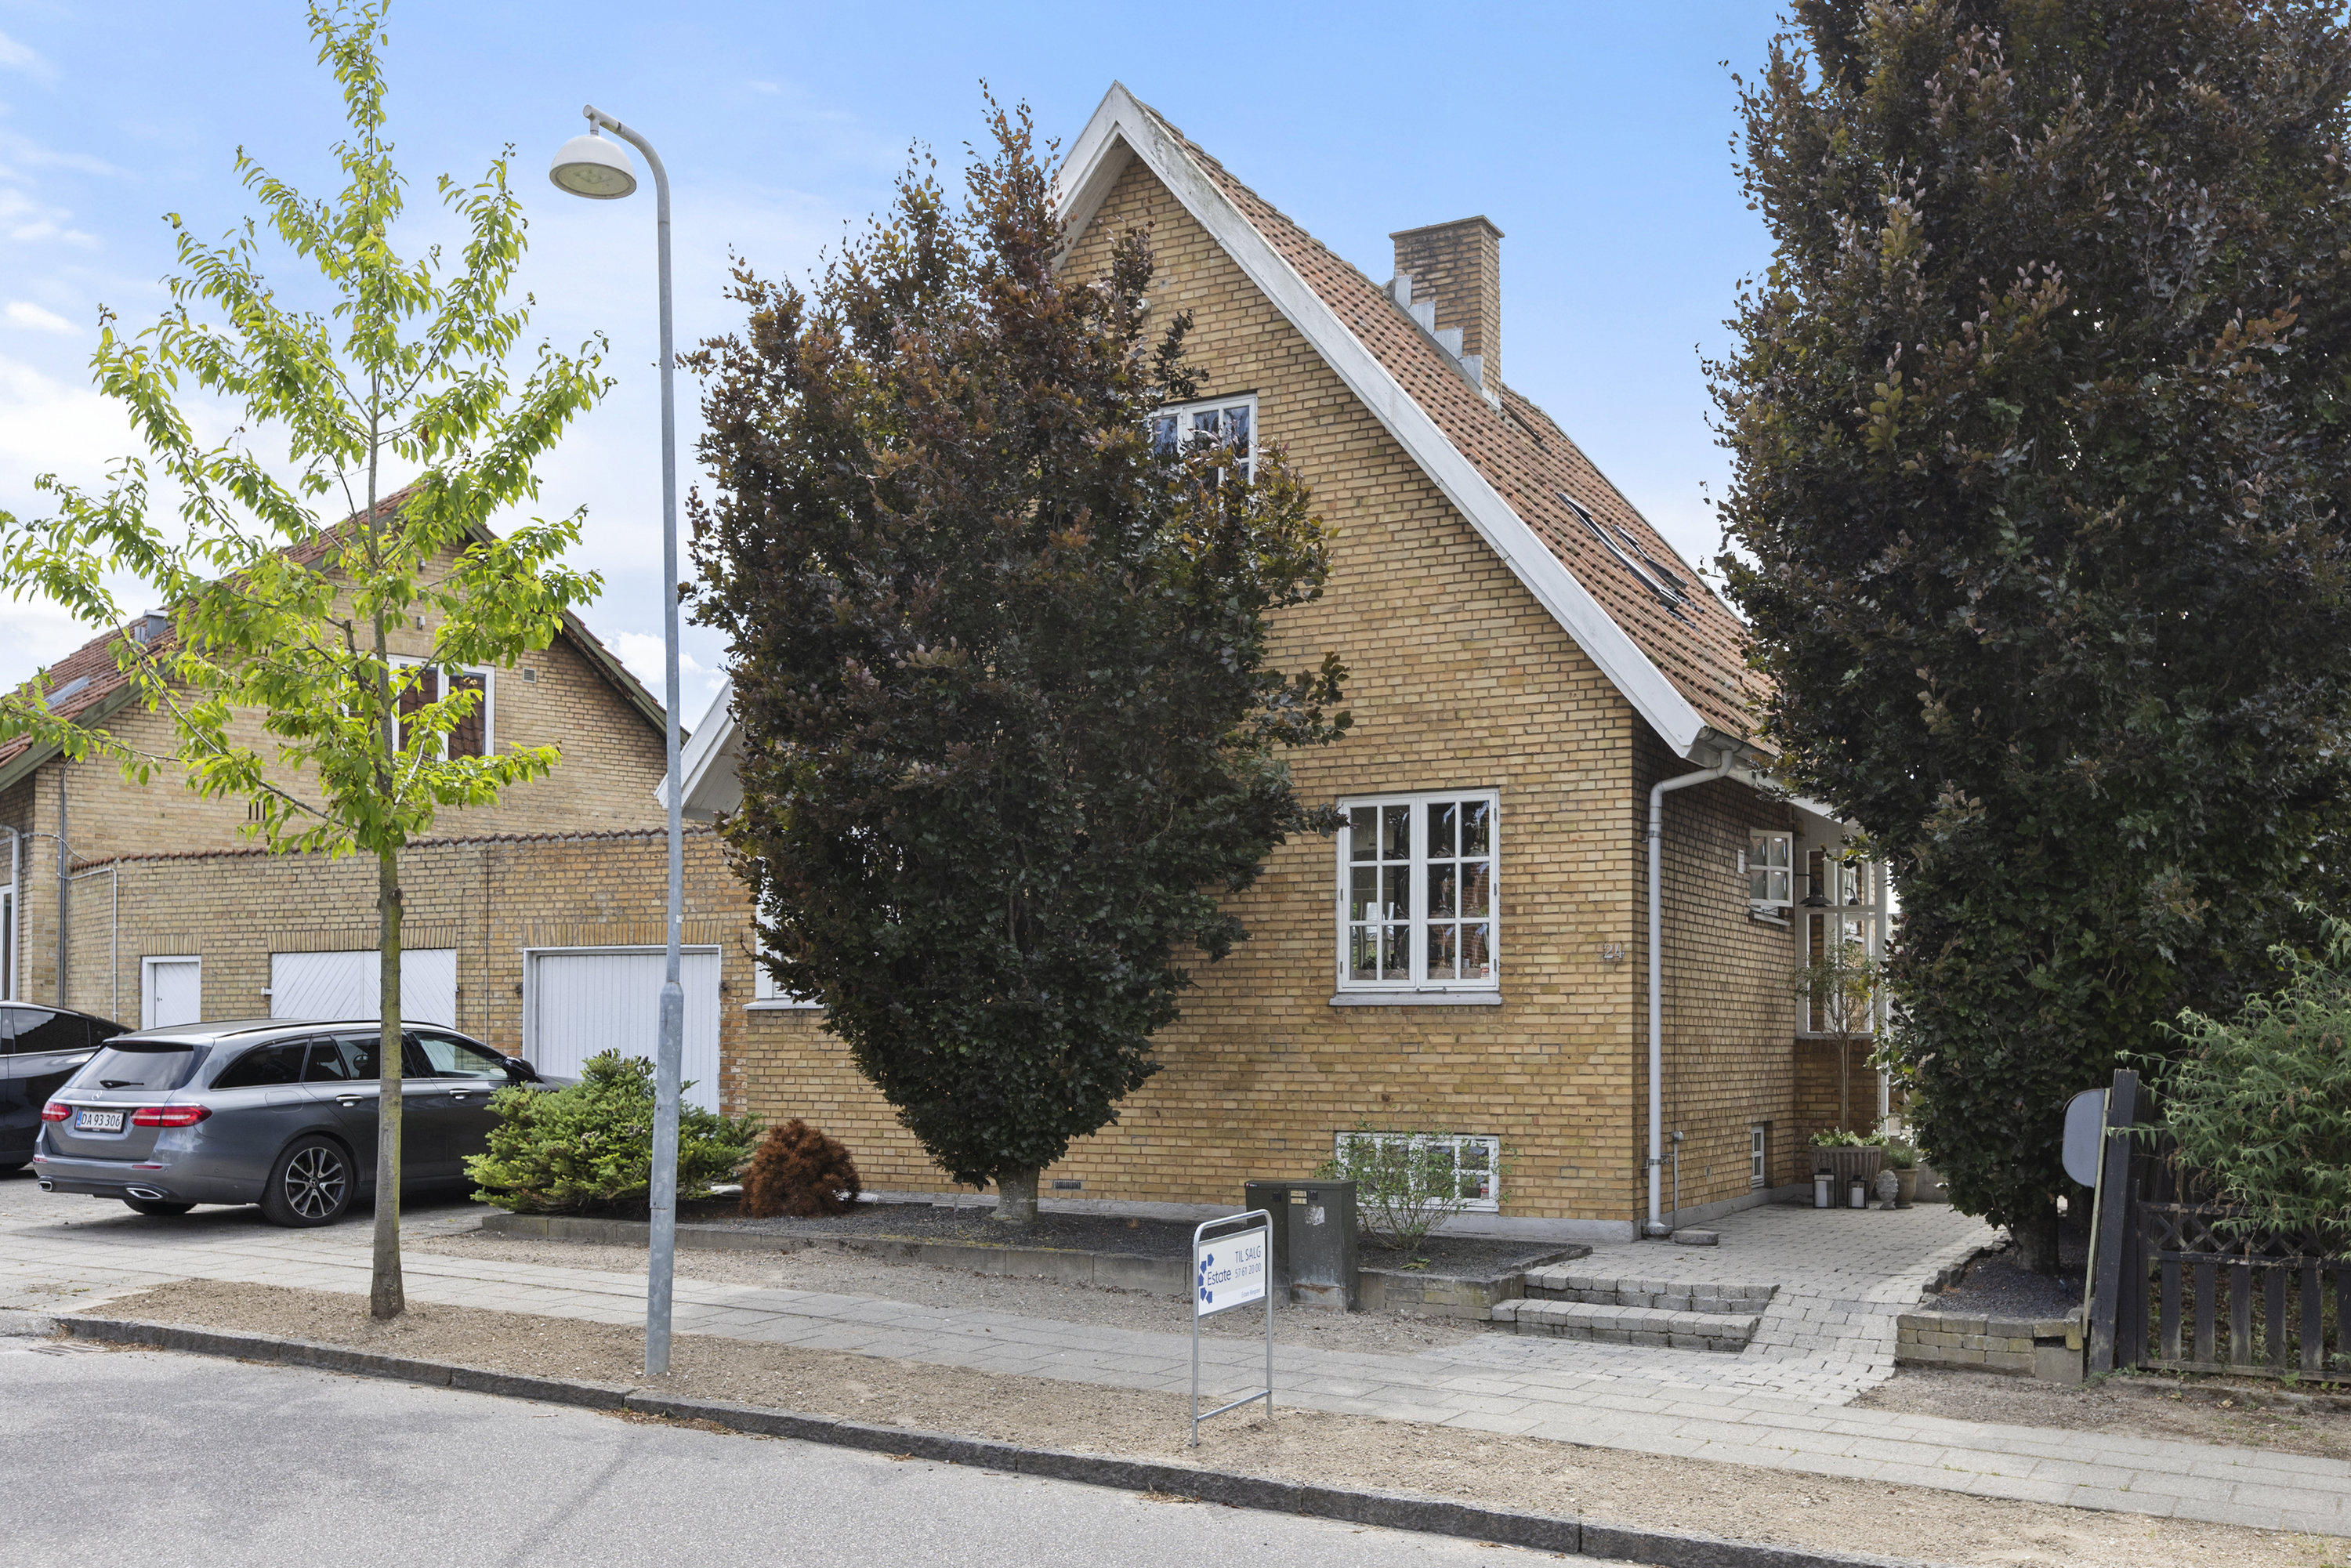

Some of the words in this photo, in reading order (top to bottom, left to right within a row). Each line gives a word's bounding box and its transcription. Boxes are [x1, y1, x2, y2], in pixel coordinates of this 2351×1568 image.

[1603, 943, 1625, 958] 24
[81, 1113, 92, 1124] DA
[94, 1114, 104, 1126] 93
[105, 1115, 121, 1127] 306
[1235, 1250, 1244, 1263] TIL
[1245, 1245, 1261, 1261] SALG
[1208, 1269, 1231, 1286] Estate
[1235, 1267, 1241, 1278] 57
[1242, 1266, 1248, 1276] 61
[1248, 1264, 1255, 1275] 20
[1255, 1262, 1261, 1273] 00
